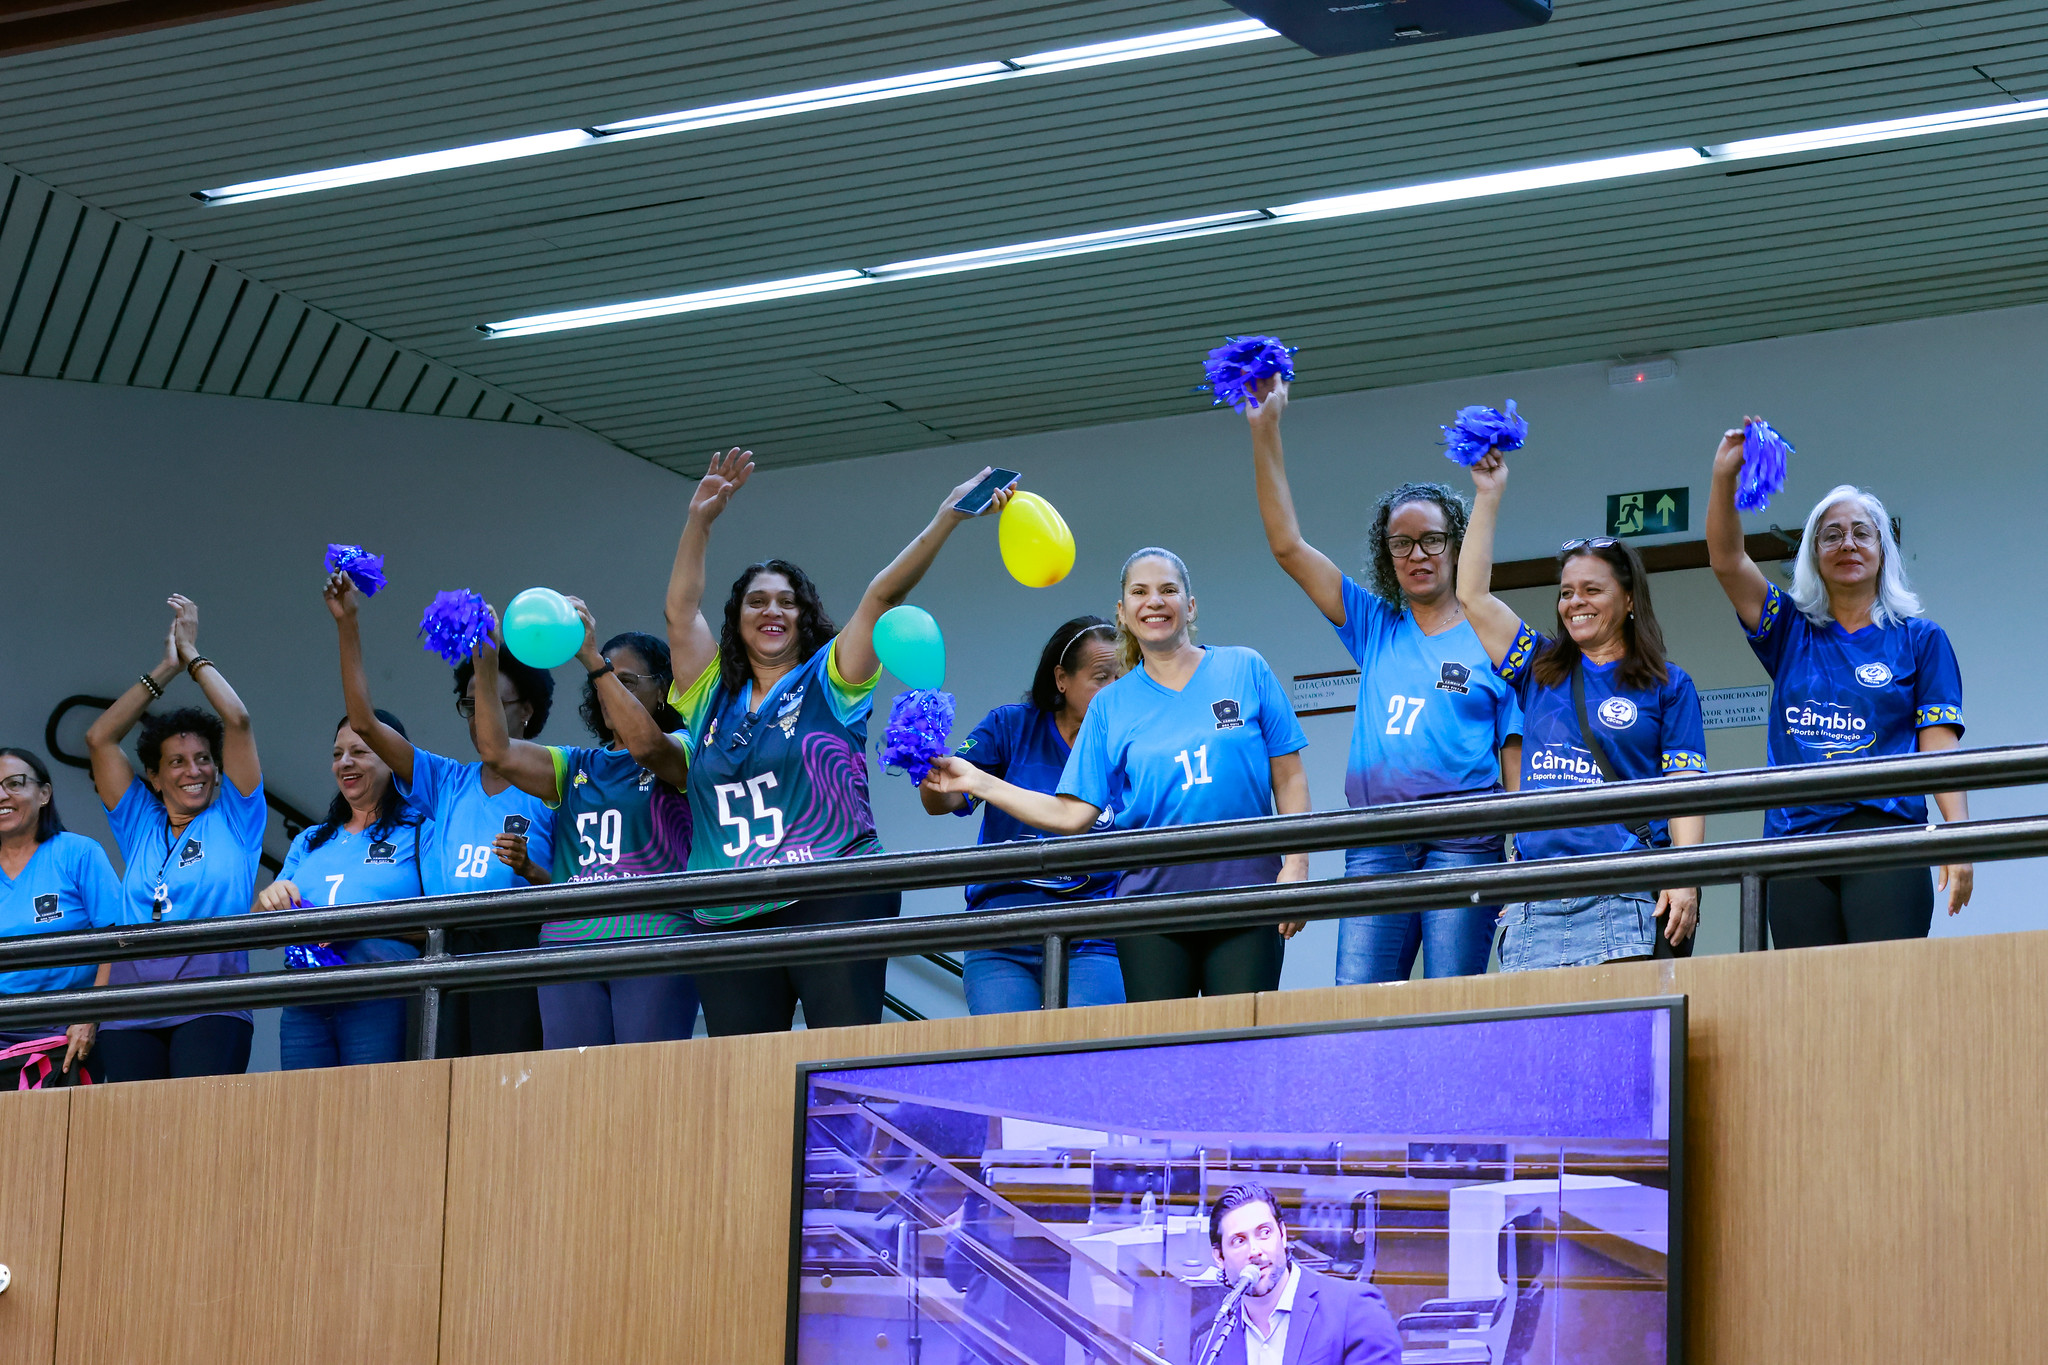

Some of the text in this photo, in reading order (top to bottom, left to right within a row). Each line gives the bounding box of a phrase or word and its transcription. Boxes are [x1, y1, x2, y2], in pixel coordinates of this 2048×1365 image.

[1333, 676, 1361, 686] MÁXIM
[1706, 690, 1768, 702] CONDICIONADO
[1385, 694, 1426, 735] 27
[1702, 709, 1722, 717] AVOR
[1725, 706, 1755, 715] MANTER
[1703, 715, 1761, 726] ORTA FECHADA
[1785, 706, 1866, 731] Câmbio
[1789, 727, 1815, 736] sporte
[1174, 744, 1213, 791] 11
[714, 771, 784, 857] 55
[576, 809, 622, 866] 59
[455, 843, 491, 878] 28
[786, 845, 814, 863] BH
[325, 873, 345, 906] 7
